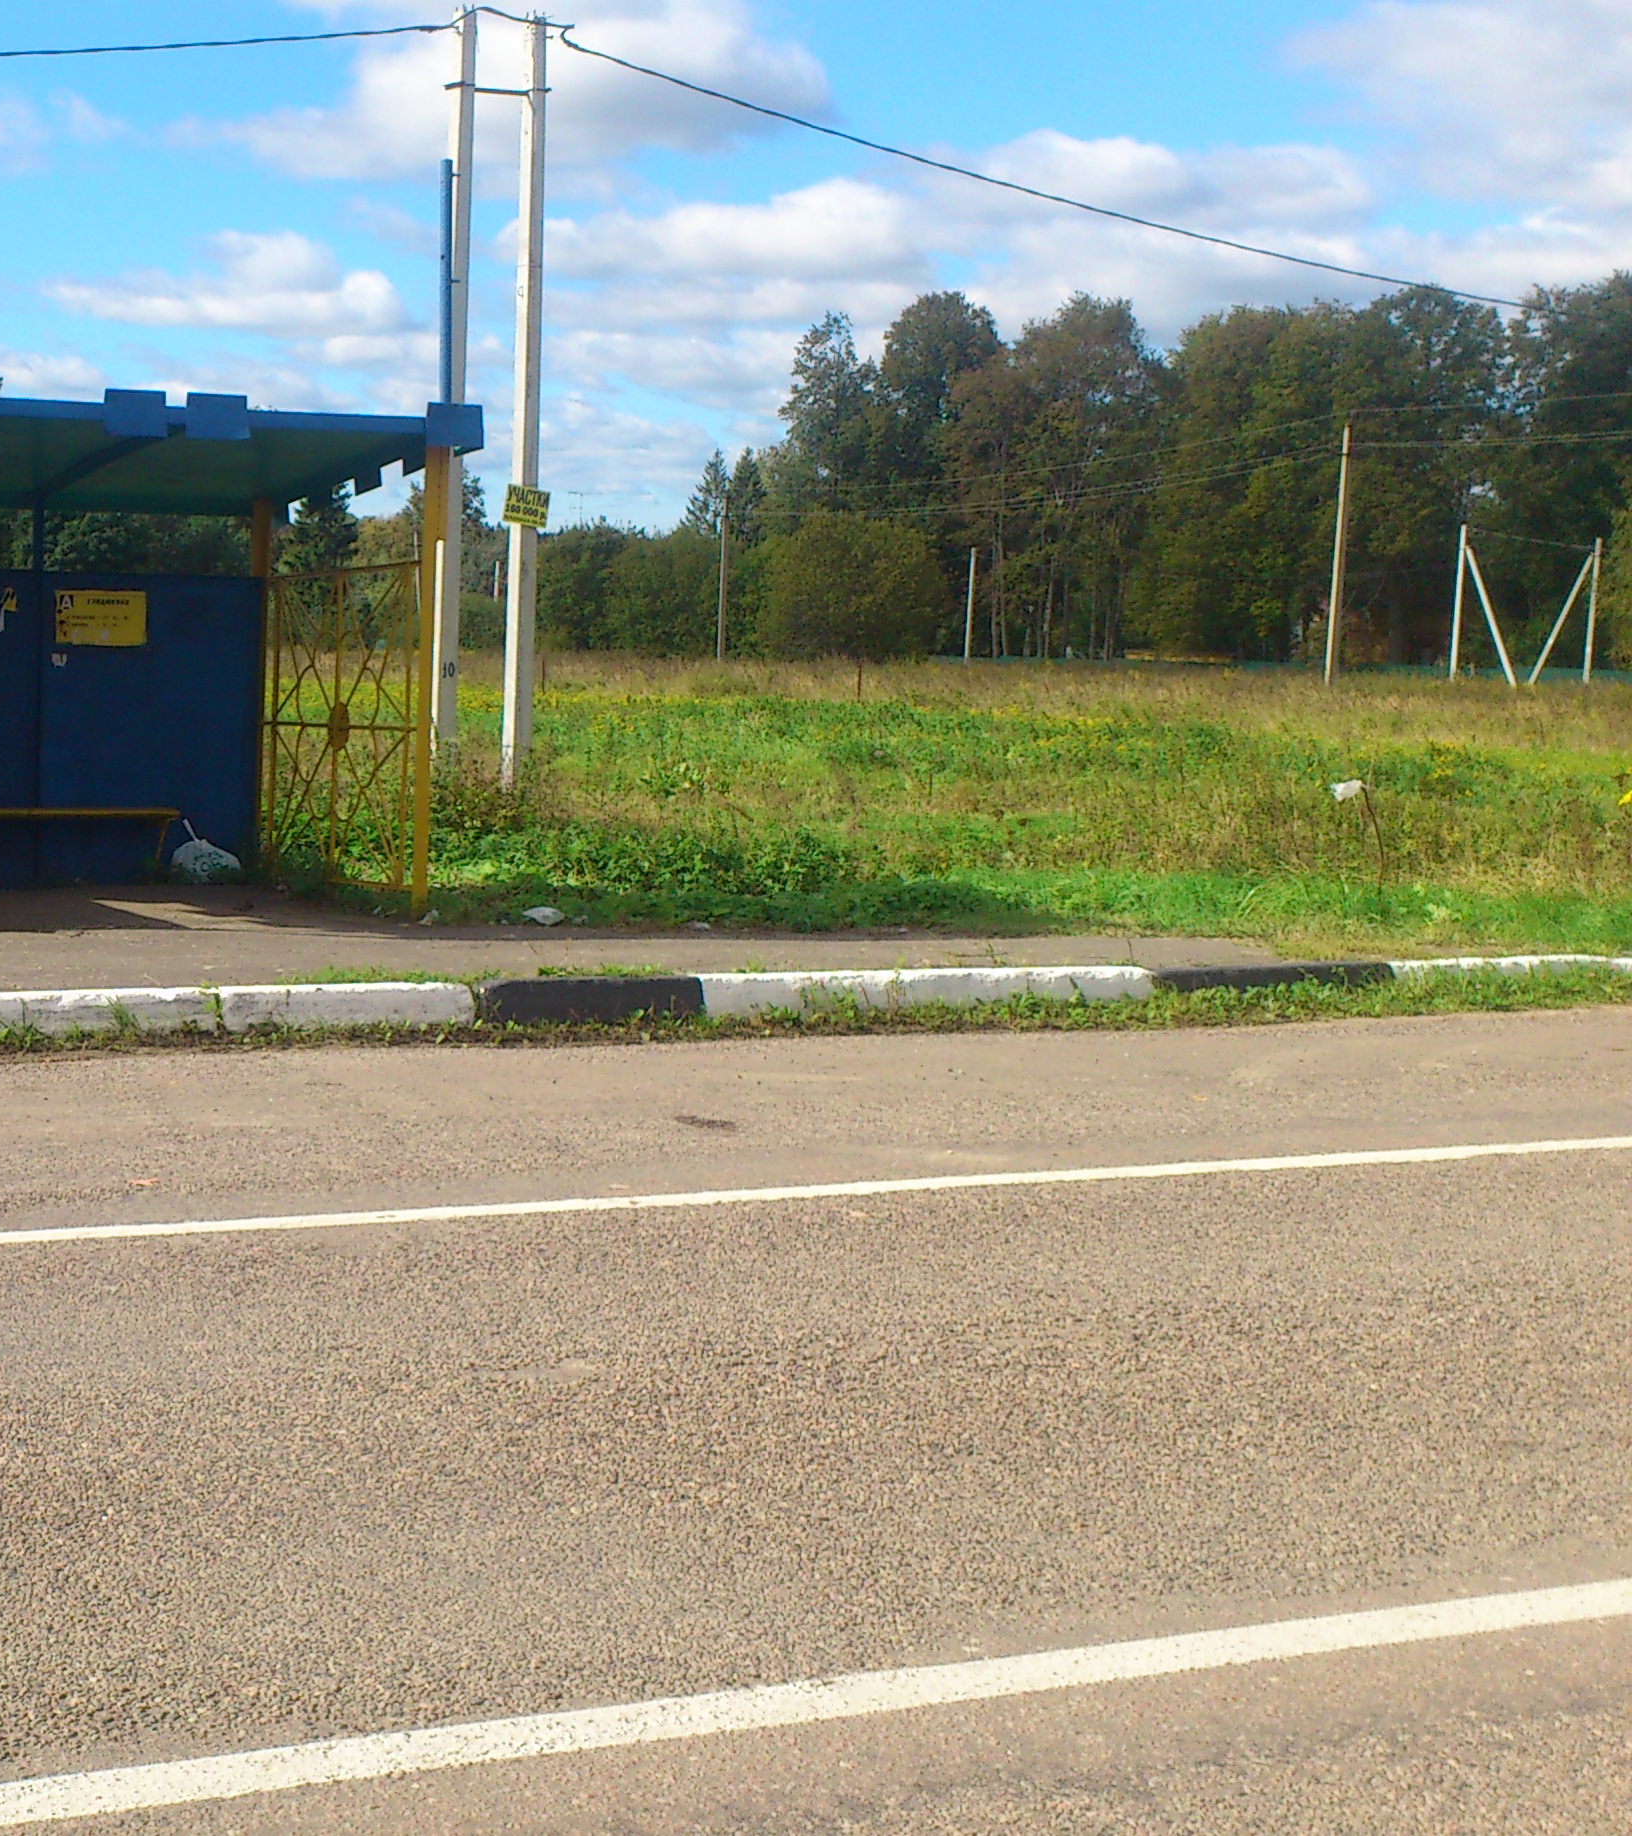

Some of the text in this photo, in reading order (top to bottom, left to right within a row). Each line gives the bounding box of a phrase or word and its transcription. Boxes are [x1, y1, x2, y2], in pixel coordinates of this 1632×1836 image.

[506, 485, 550, 508] УЧАСТКИ
[522, 507, 539, 518] 000
[443, 662, 455, 678] 10
